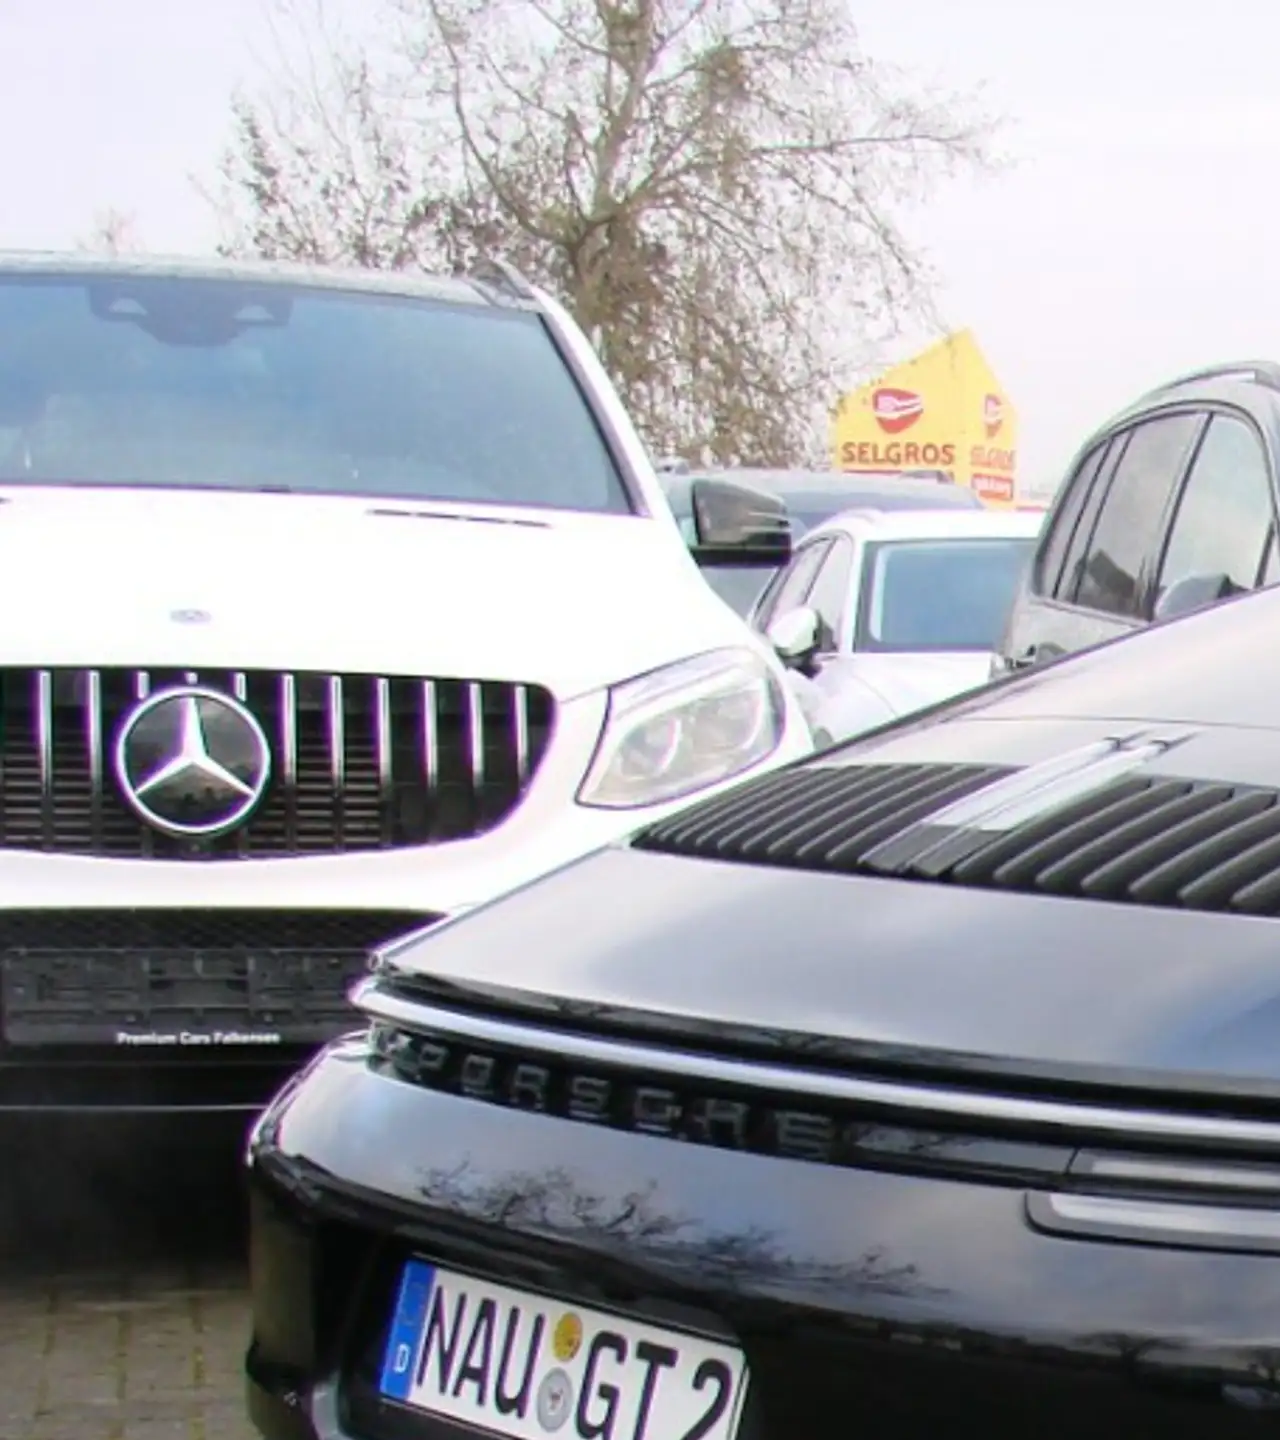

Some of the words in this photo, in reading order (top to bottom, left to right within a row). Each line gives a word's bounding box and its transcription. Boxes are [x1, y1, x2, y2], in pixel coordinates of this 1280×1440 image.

[841, 441, 955, 466] SELGROS
[117, 1032, 177, 1045] Premium
[180, 1031, 210, 1045] Cars
[418, 1042, 832, 1163] PORSCHE
[393, 1344, 409, 1373] D
[416, 1284, 546, 1419] NAU
